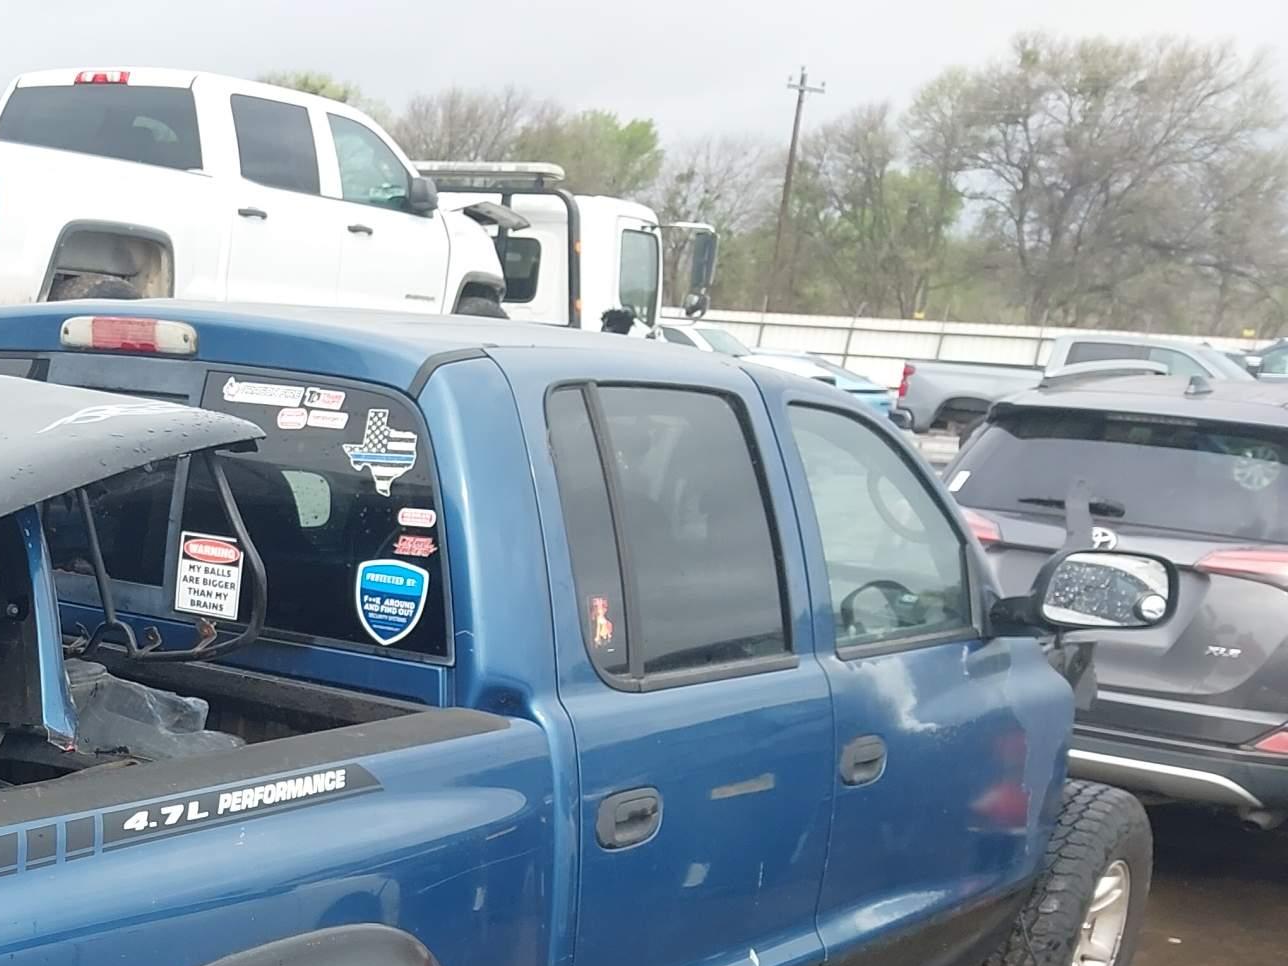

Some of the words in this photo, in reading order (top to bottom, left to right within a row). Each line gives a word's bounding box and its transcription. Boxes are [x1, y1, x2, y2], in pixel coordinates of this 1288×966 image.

[189, 543, 236, 559] WARNING
[189, 564, 202, 573] MY
[204, 567, 232, 577] BALLS
[182, 575, 200, 585] ARE
[202, 578, 236, 590] BIGGER
[187, 587, 213, 598] THAN
[215, 592, 229, 600] MY
[190, 599, 224, 611] BRAINS
[364, 603, 380, 613] AND
[380, 605, 397, 615] FIND
[398, 608, 414, 617] OUT
[384, 597, 416, 610] AROUND
[217, 769, 346, 815] PERFORMANCE
